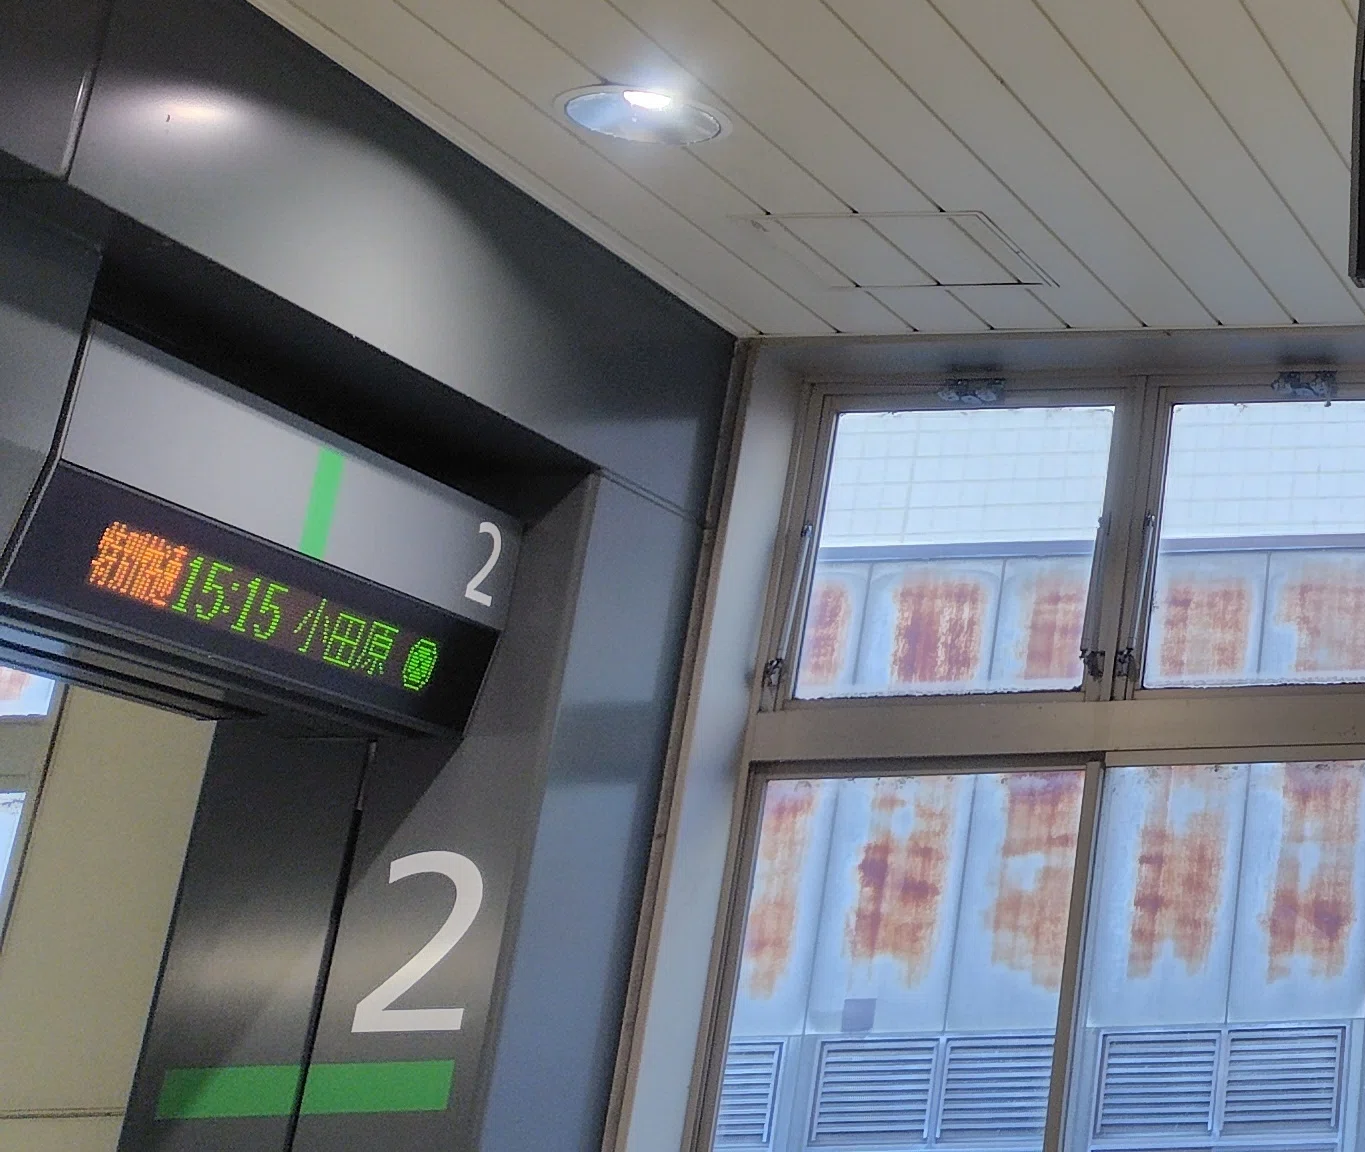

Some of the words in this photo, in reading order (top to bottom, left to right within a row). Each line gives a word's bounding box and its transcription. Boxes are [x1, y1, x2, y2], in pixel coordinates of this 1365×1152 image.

[171, 555, 289, 641] 15:15
[292, 598, 400, 676] 小田原
[464, 521, 502, 608] 2
[350, 850, 484, 1034] 2
